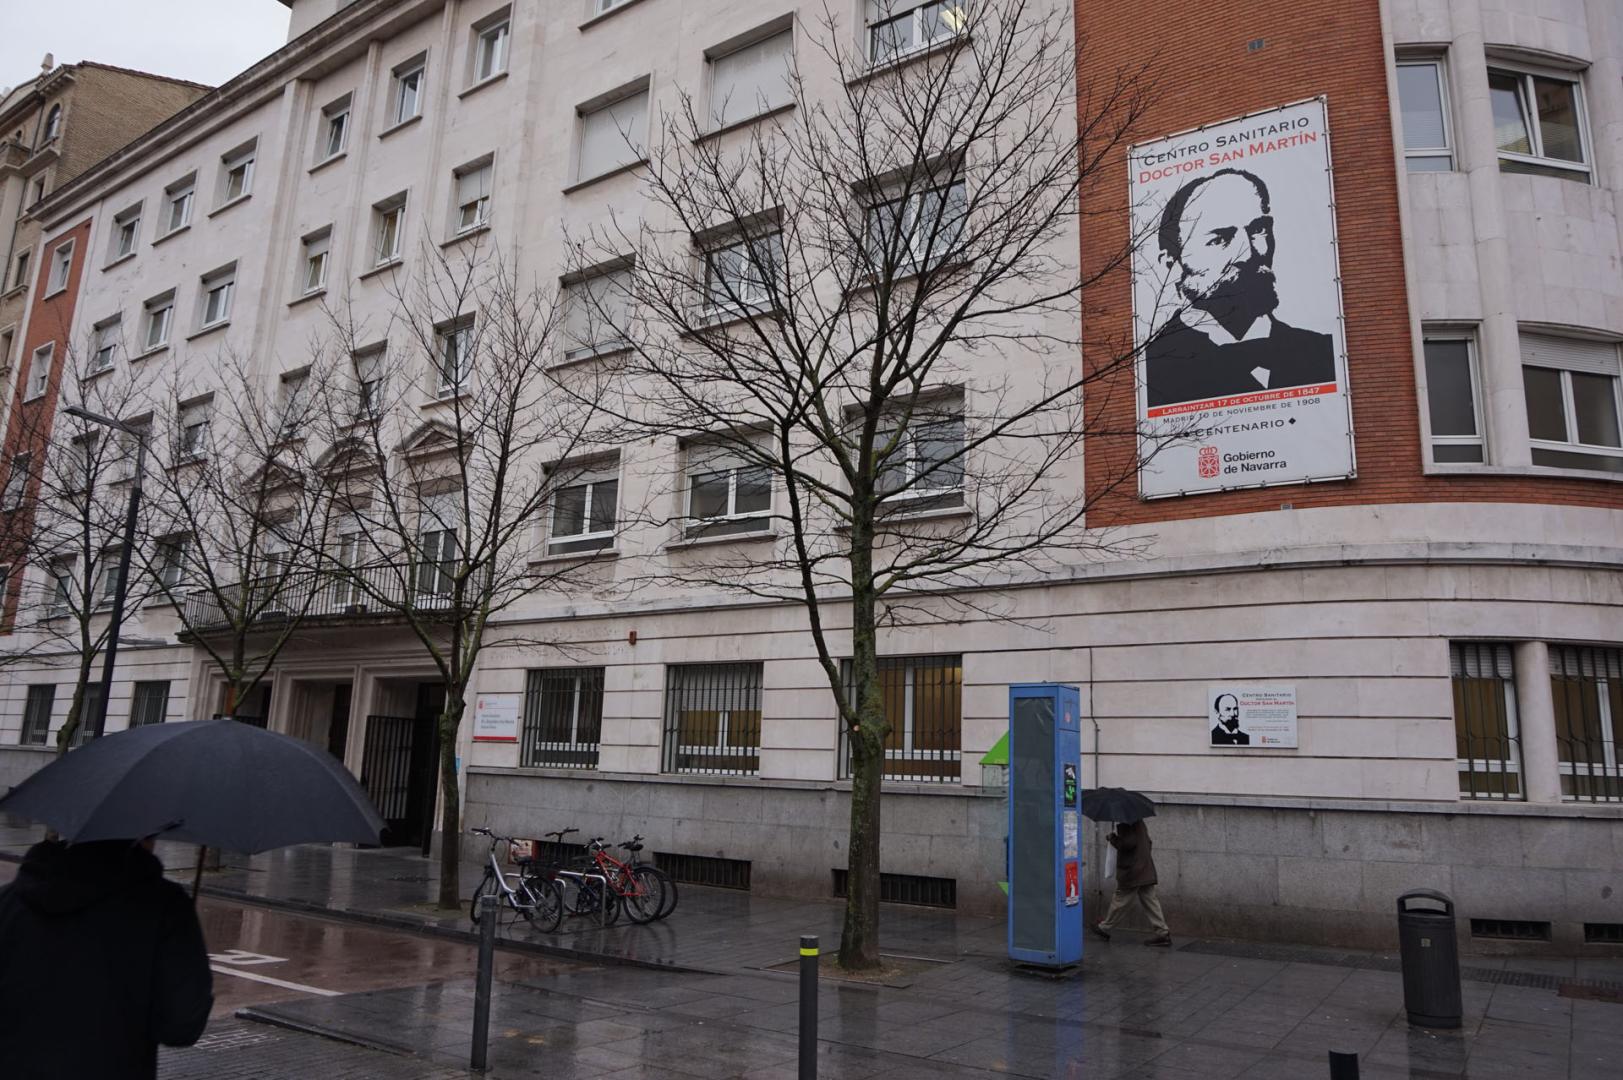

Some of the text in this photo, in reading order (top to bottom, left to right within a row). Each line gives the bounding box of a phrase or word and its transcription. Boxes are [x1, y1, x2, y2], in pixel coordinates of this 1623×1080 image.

[1144, 117, 1309, 166] CENTRO SANITARIO
[1139, 131, 1317, 184] DOCTOR SAN MARTÍN
[1162, 402, 1214, 415] LARRAINTZAR
[1217, 399, 1228, 407] 17
[1242, 393, 1281, 403] OCTUBRE
[1297, 387, 1320, 396] 1847
[1163, 414, 1195, 424] MADRID
[1227, 403, 1277, 415] NOVIEMBRE
[1297, 397, 1321, 406] 1908
[1195, 419, 1285, 437] CENTENARIO
[1223, 450, 1275, 463] Gobierno
[1223, 460, 1287, 474] de Navarra
